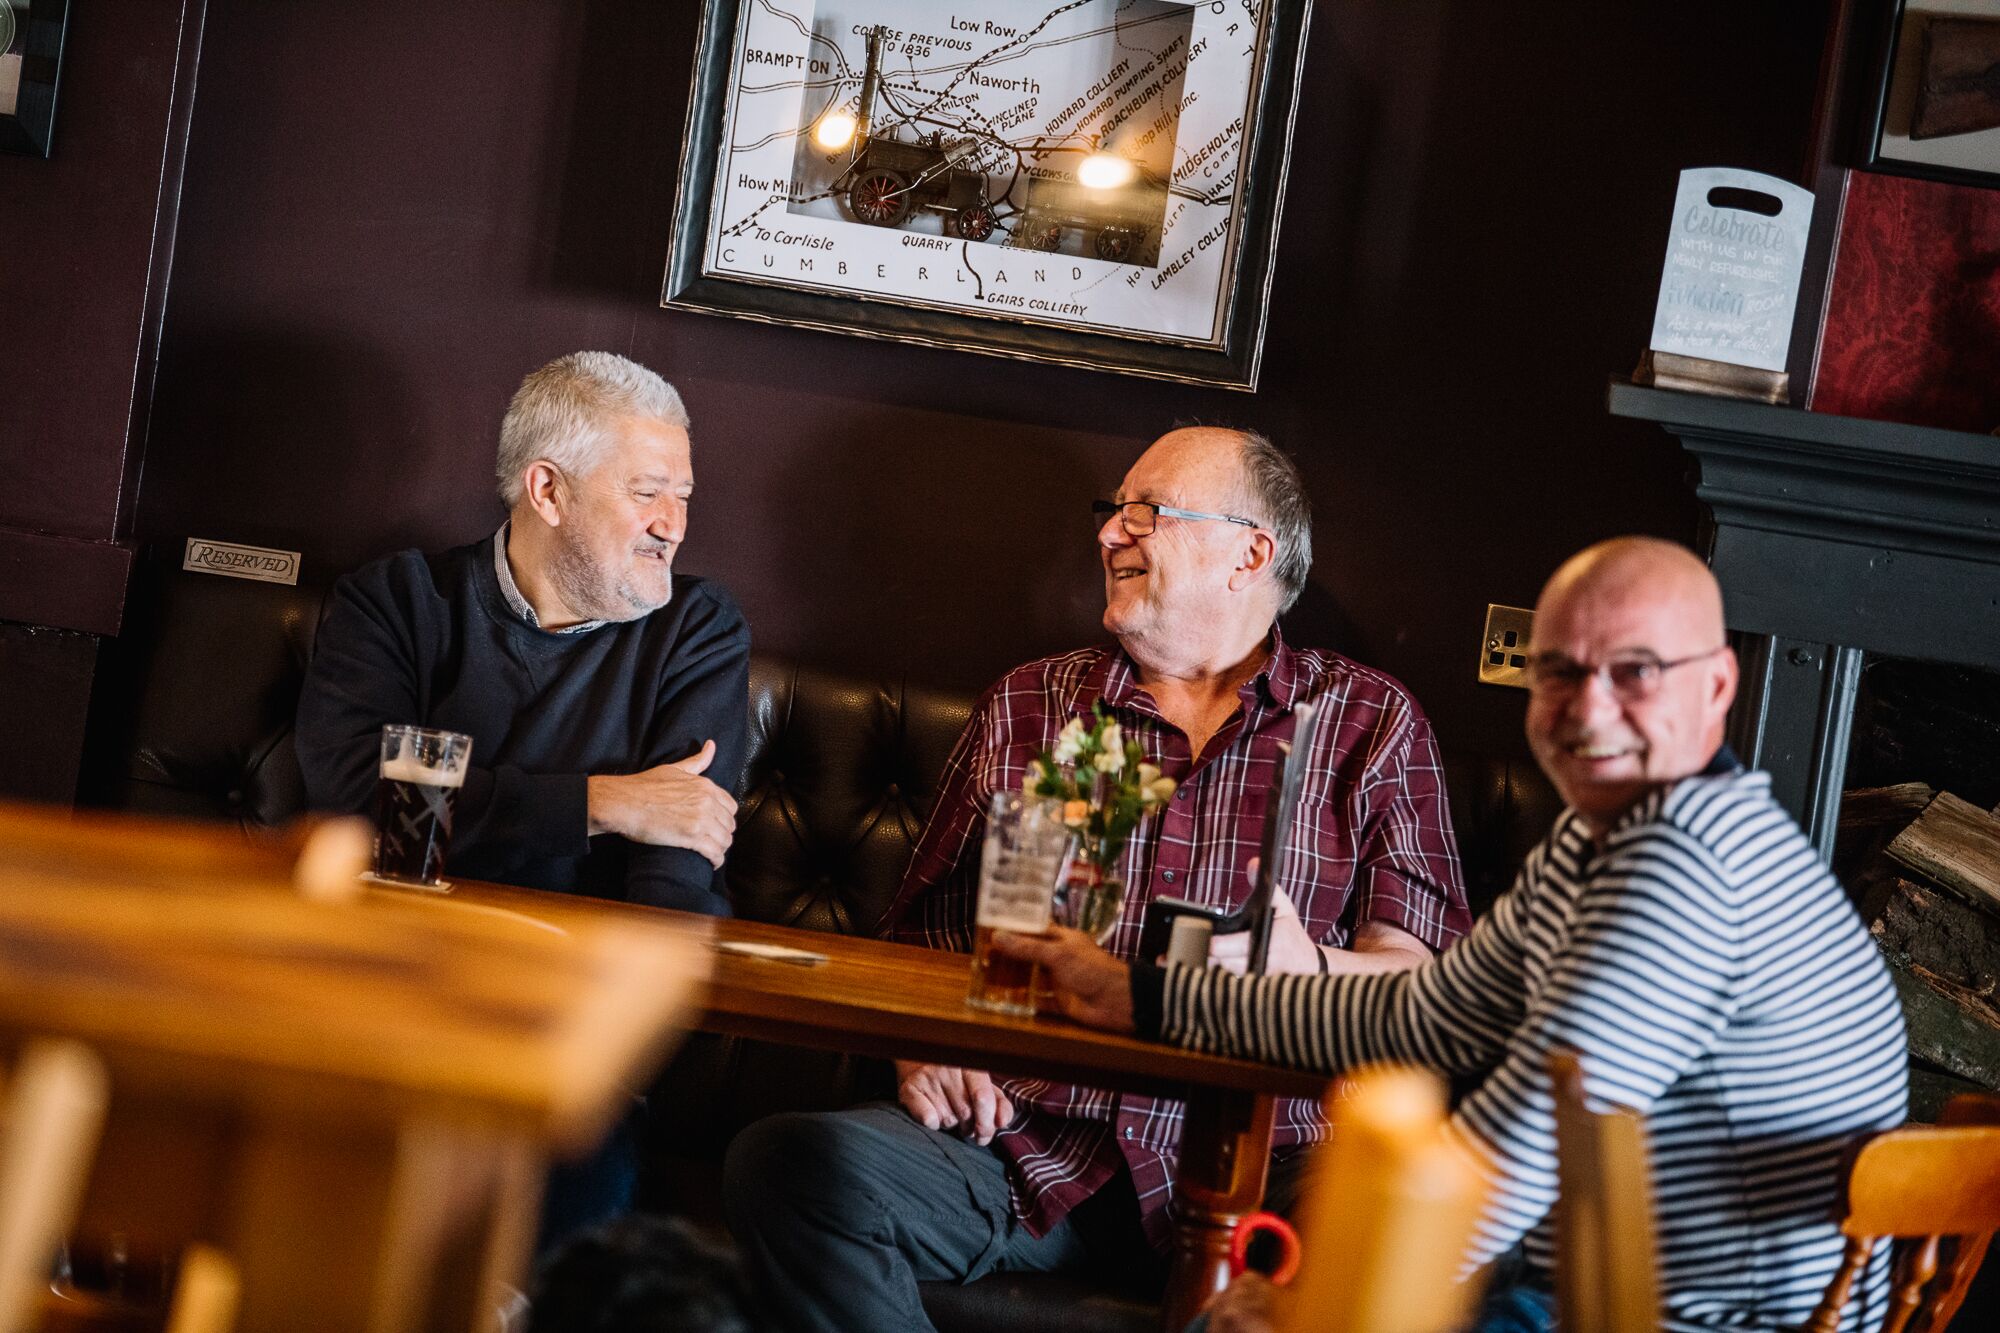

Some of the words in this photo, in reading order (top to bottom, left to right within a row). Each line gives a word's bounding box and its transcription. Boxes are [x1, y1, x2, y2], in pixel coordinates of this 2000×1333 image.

[951, 16, 980, 32] Low
[985, 21, 1016, 38] Row
[884, 41, 896, 52] O
[900, 43, 931, 58] 1836
[909, 34, 972, 51] PREVIOUS
[746, 49, 830, 75] BRAMPTON
[969, 71, 1040, 94] Naworth
[1076, 98, 1114, 132] HOWARD
[1114, 61, 1155, 99] PUMPING
[1156, 35, 1185, 65] SHAFT
[1100, 81, 1162, 138] ROACHBURN
[1162, 37, 1208, 85] COLLIERY
[941, 93, 980, 111] MILTON
[1045, 98, 1086, 136] HOWARD
[1087, 59, 1131, 100] COLLIERY
[991, 97, 1038, 125] INCLINED
[1001, 109, 1036, 132] PLANE
[1173, 118, 1243, 183] MIDGEHOLME
[738, 174, 769, 192] How
[755, 227, 771, 241] To
[774, 230, 834, 250] Carlisle
[1683, 205, 1785, 251] Celebrate
[902, 235, 952, 251] QUARRY
[1681, 238, 1713, 253] WITH
[1718, 245, 1737, 259] US
[1151, 247, 1196, 290] LAMBLEY
[987, 293, 1024, 307] GAIRS
[1029, 298, 1088, 317] COLLIERY
[194, 546, 289, 572] RESERVED
